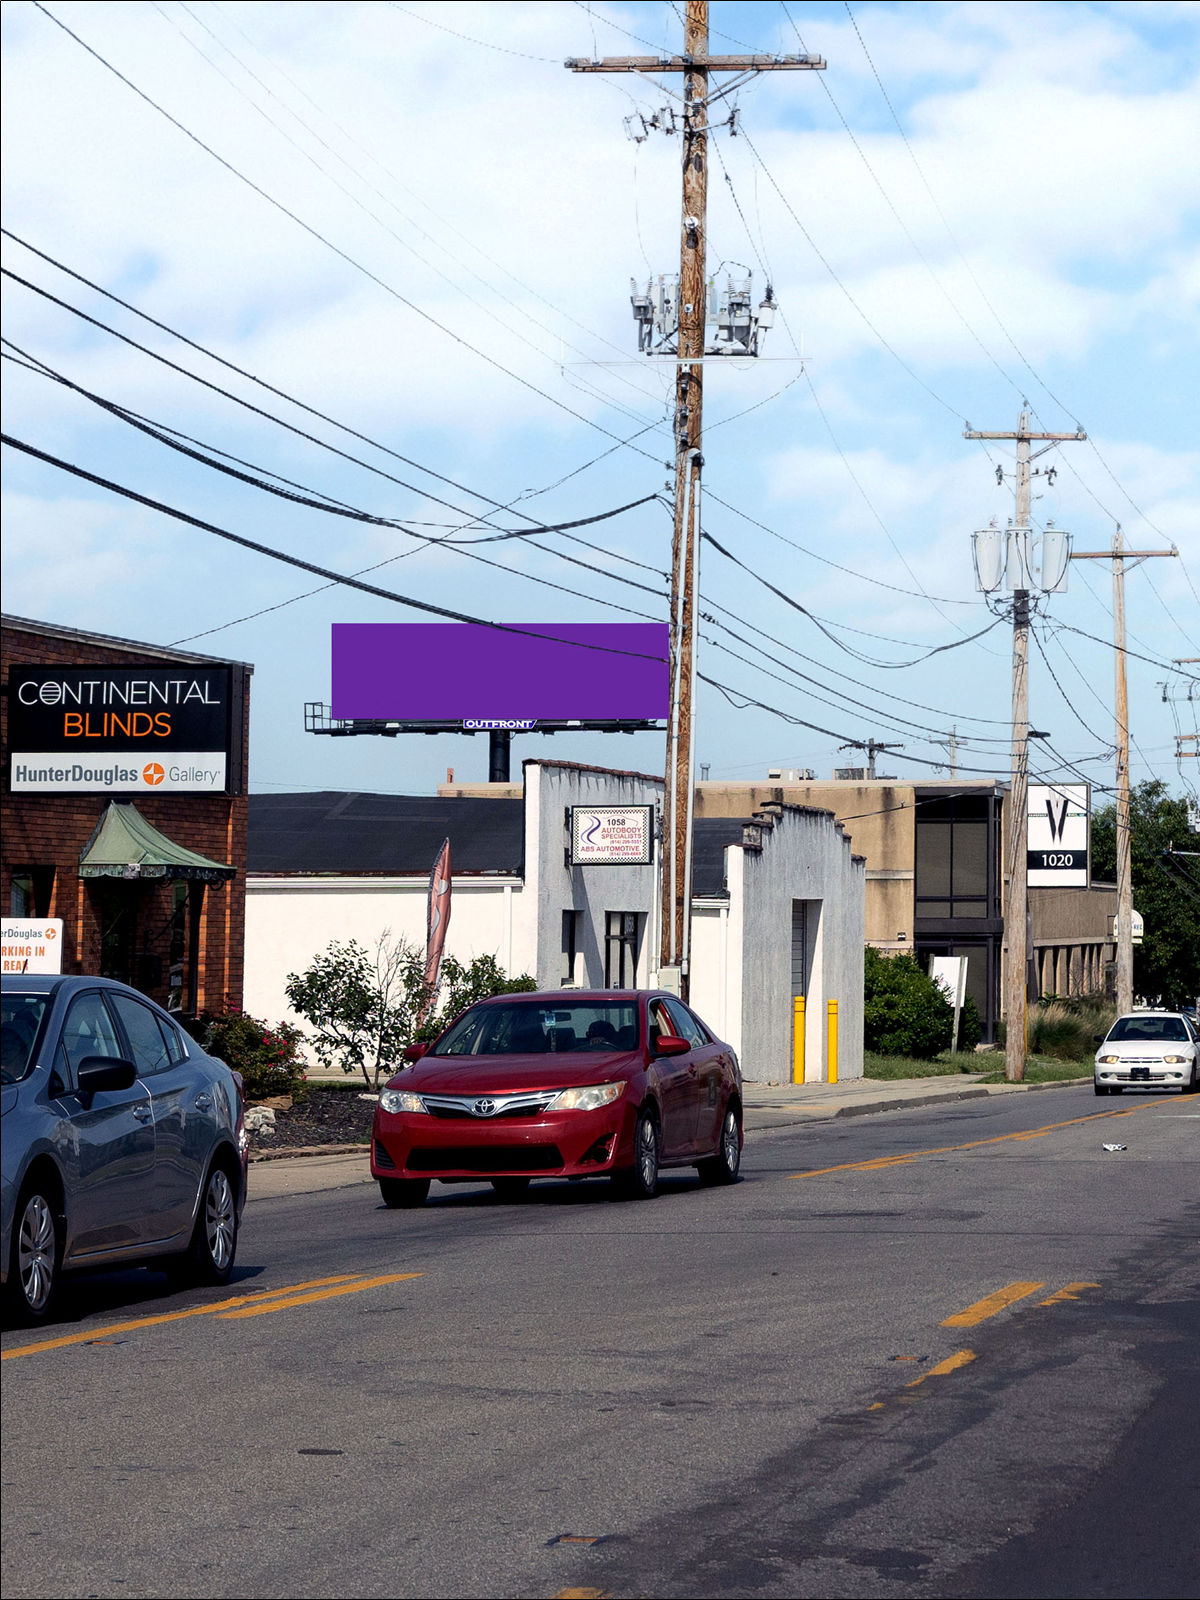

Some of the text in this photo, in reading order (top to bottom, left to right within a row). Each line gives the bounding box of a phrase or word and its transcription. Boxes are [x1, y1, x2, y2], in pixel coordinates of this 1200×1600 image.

[18, 680, 221, 705] CONTINENTAL
[64, 712, 171, 737] BLINDS
[466, 720, 533, 728] OUTFRONT
[16, 765, 217, 785] HunterDouglas Gallery
[1042, 854, 1073, 866] 1020
[35, 946, 45, 956] IN
